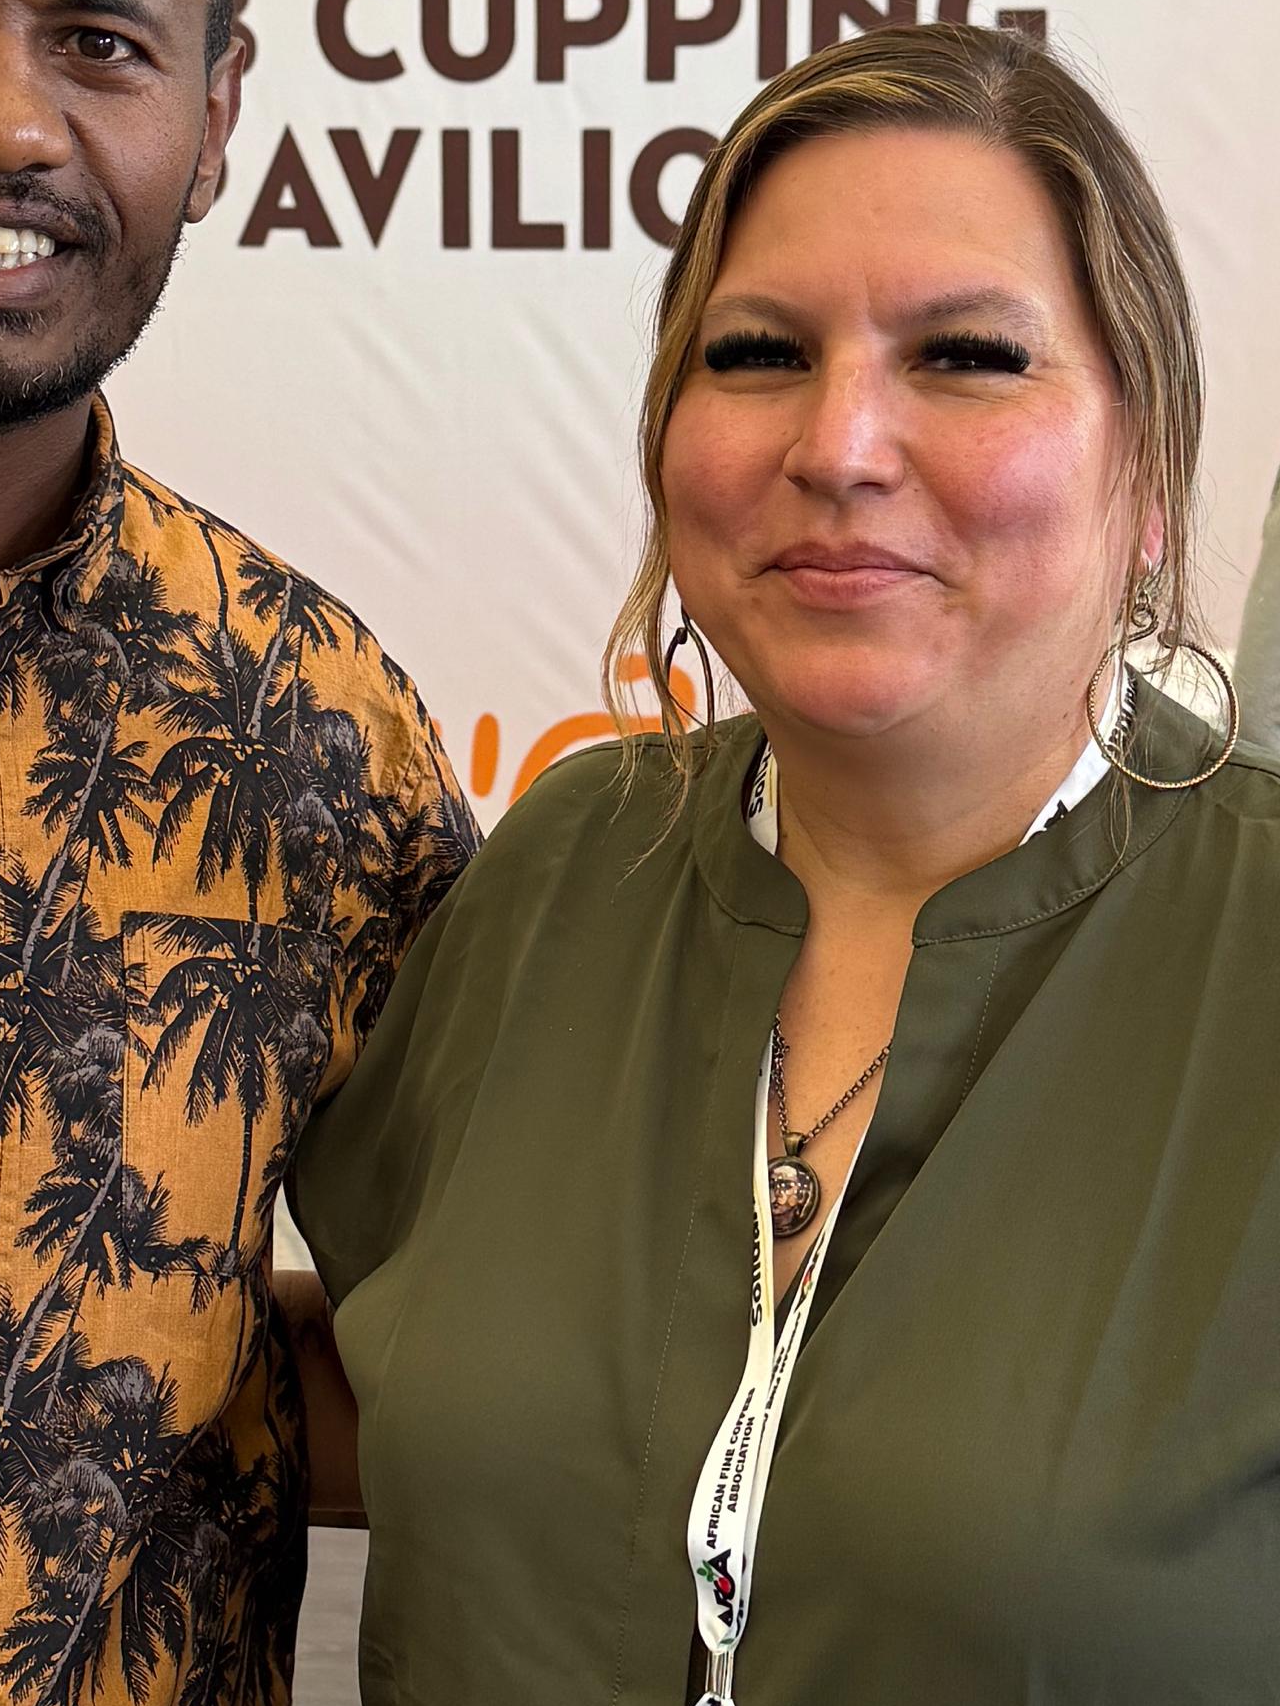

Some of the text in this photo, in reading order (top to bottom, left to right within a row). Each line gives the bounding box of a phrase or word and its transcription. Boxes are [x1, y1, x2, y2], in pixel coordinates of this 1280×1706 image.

[216, 125, 722, 250] AVILIO
[706, 1481, 727, 1550] AFRICAN
[719, 1447, 735, 1480] FINE
[726, 1416, 756, 1513] ASSOCIATION
